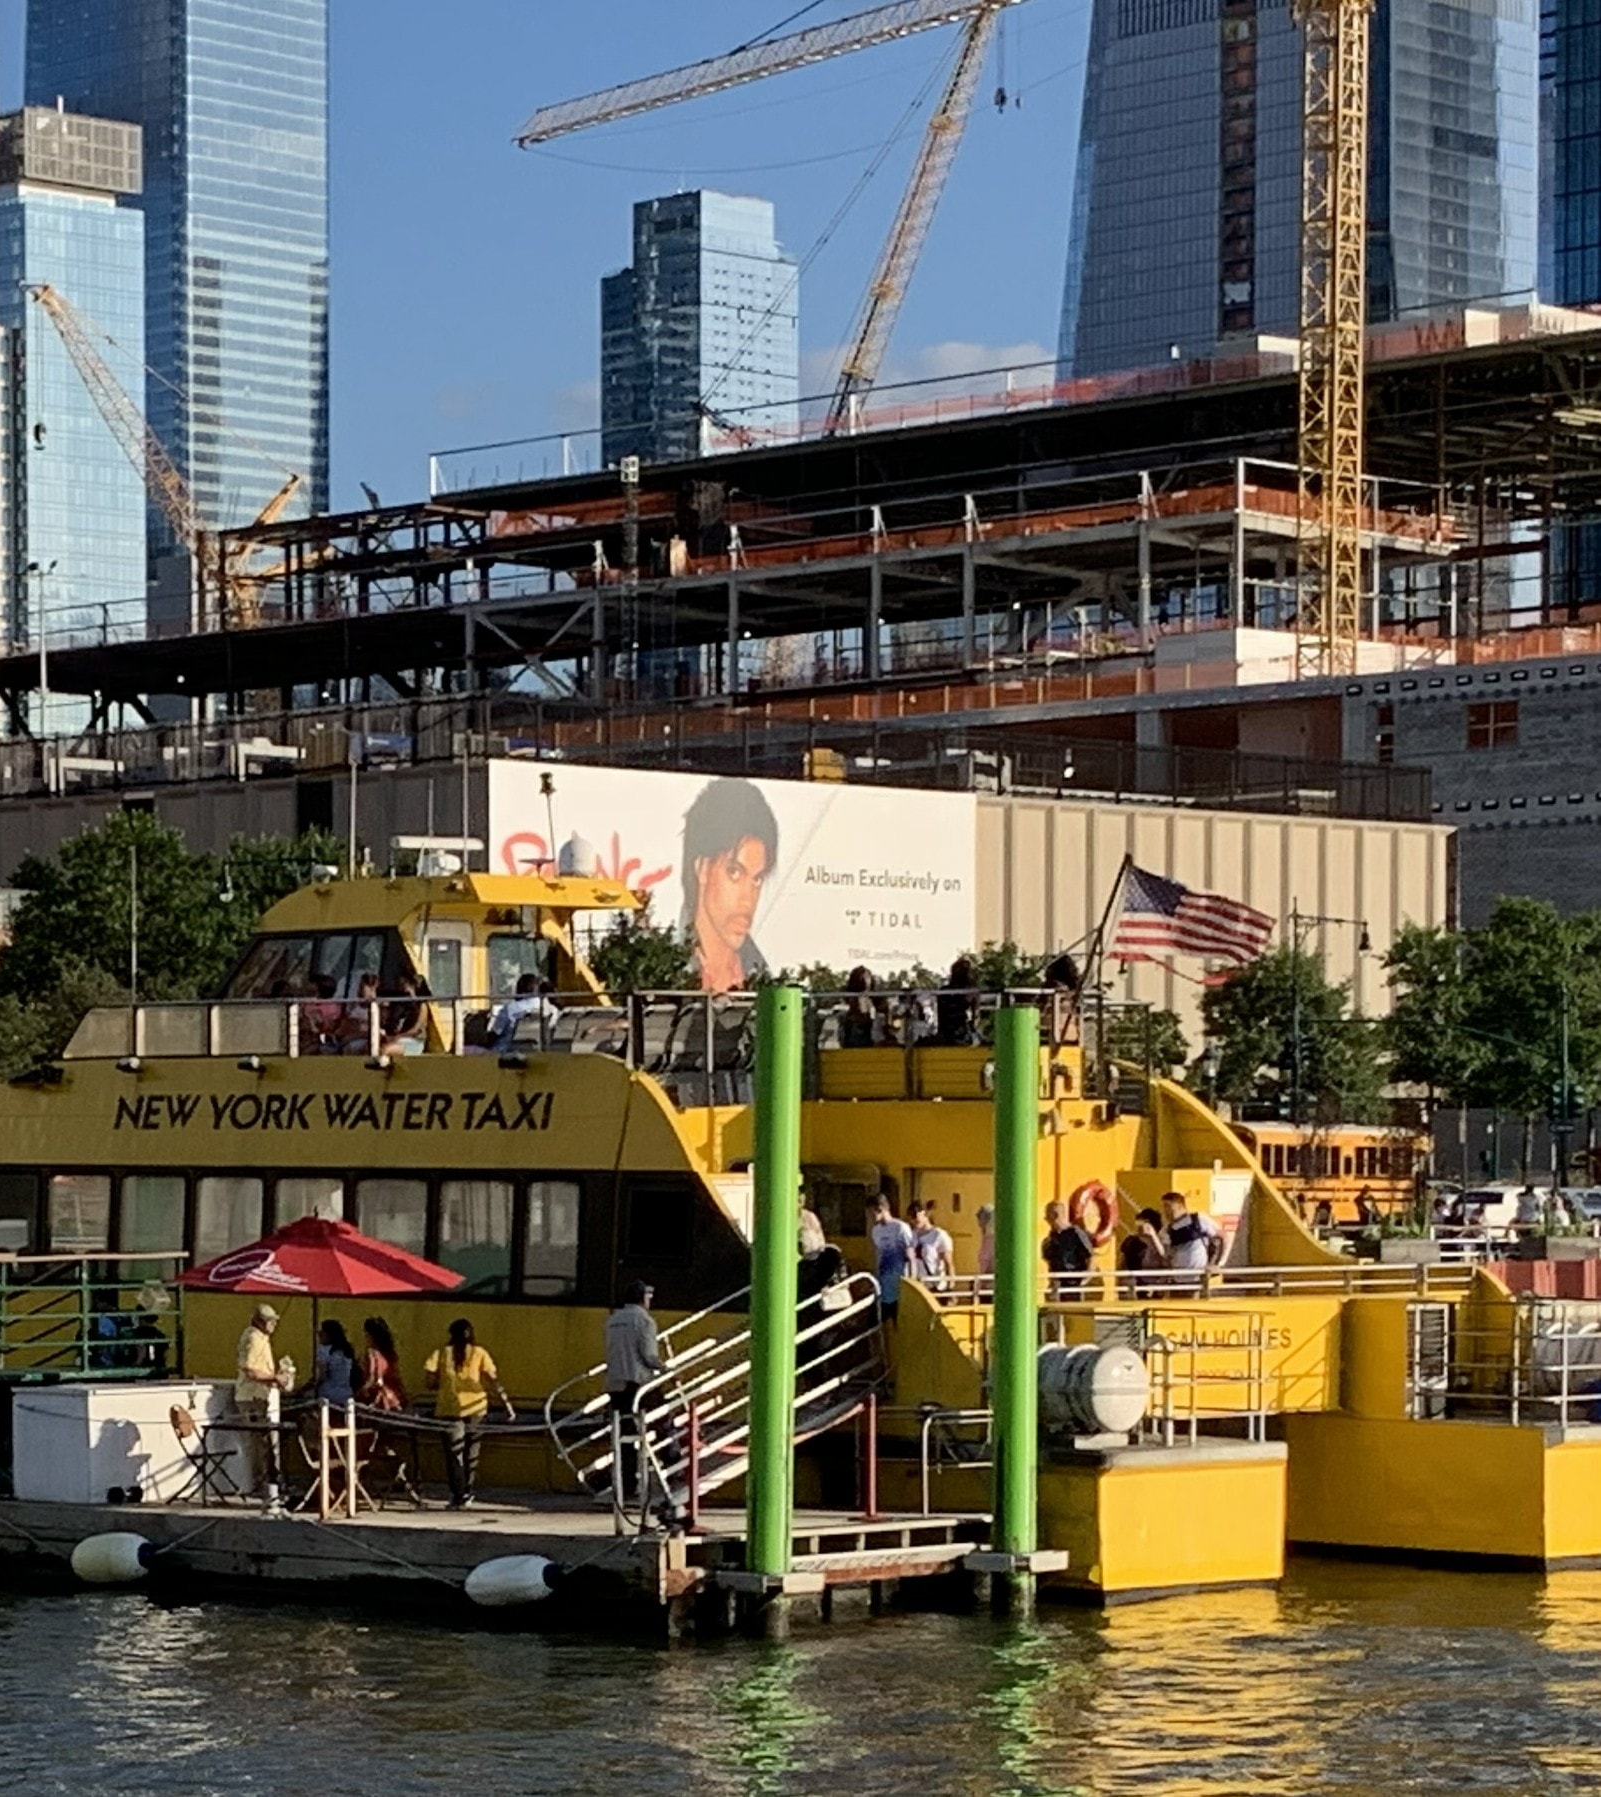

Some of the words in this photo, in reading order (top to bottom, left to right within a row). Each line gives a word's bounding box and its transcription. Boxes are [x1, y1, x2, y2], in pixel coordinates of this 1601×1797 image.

[804, 865, 855, 886] Album
[859, 869, 940, 895] Exclusively
[943, 878, 961, 891] on
[868, 911, 923, 929] TIDAL
[113, 1094, 202, 1130] NEW
[209, 1093, 317, 1130] YORK
[323, 1092, 455, 1130] WATER
[461, 1092, 556, 1130] TAXI
